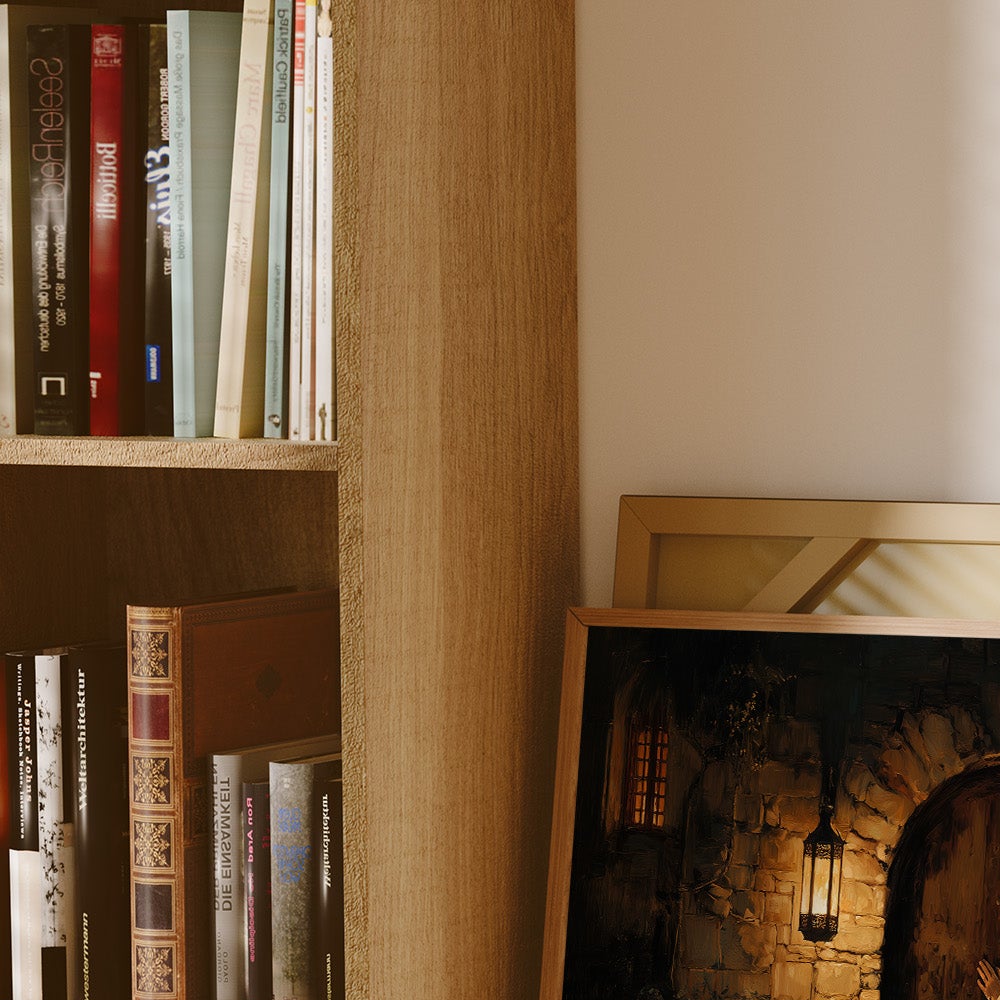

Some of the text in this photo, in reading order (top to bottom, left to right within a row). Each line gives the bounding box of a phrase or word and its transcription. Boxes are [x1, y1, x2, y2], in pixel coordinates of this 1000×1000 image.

[24, 700, 34, 803] Jasper Johns
[78, 669, 87, 811] Weltarchitektur
